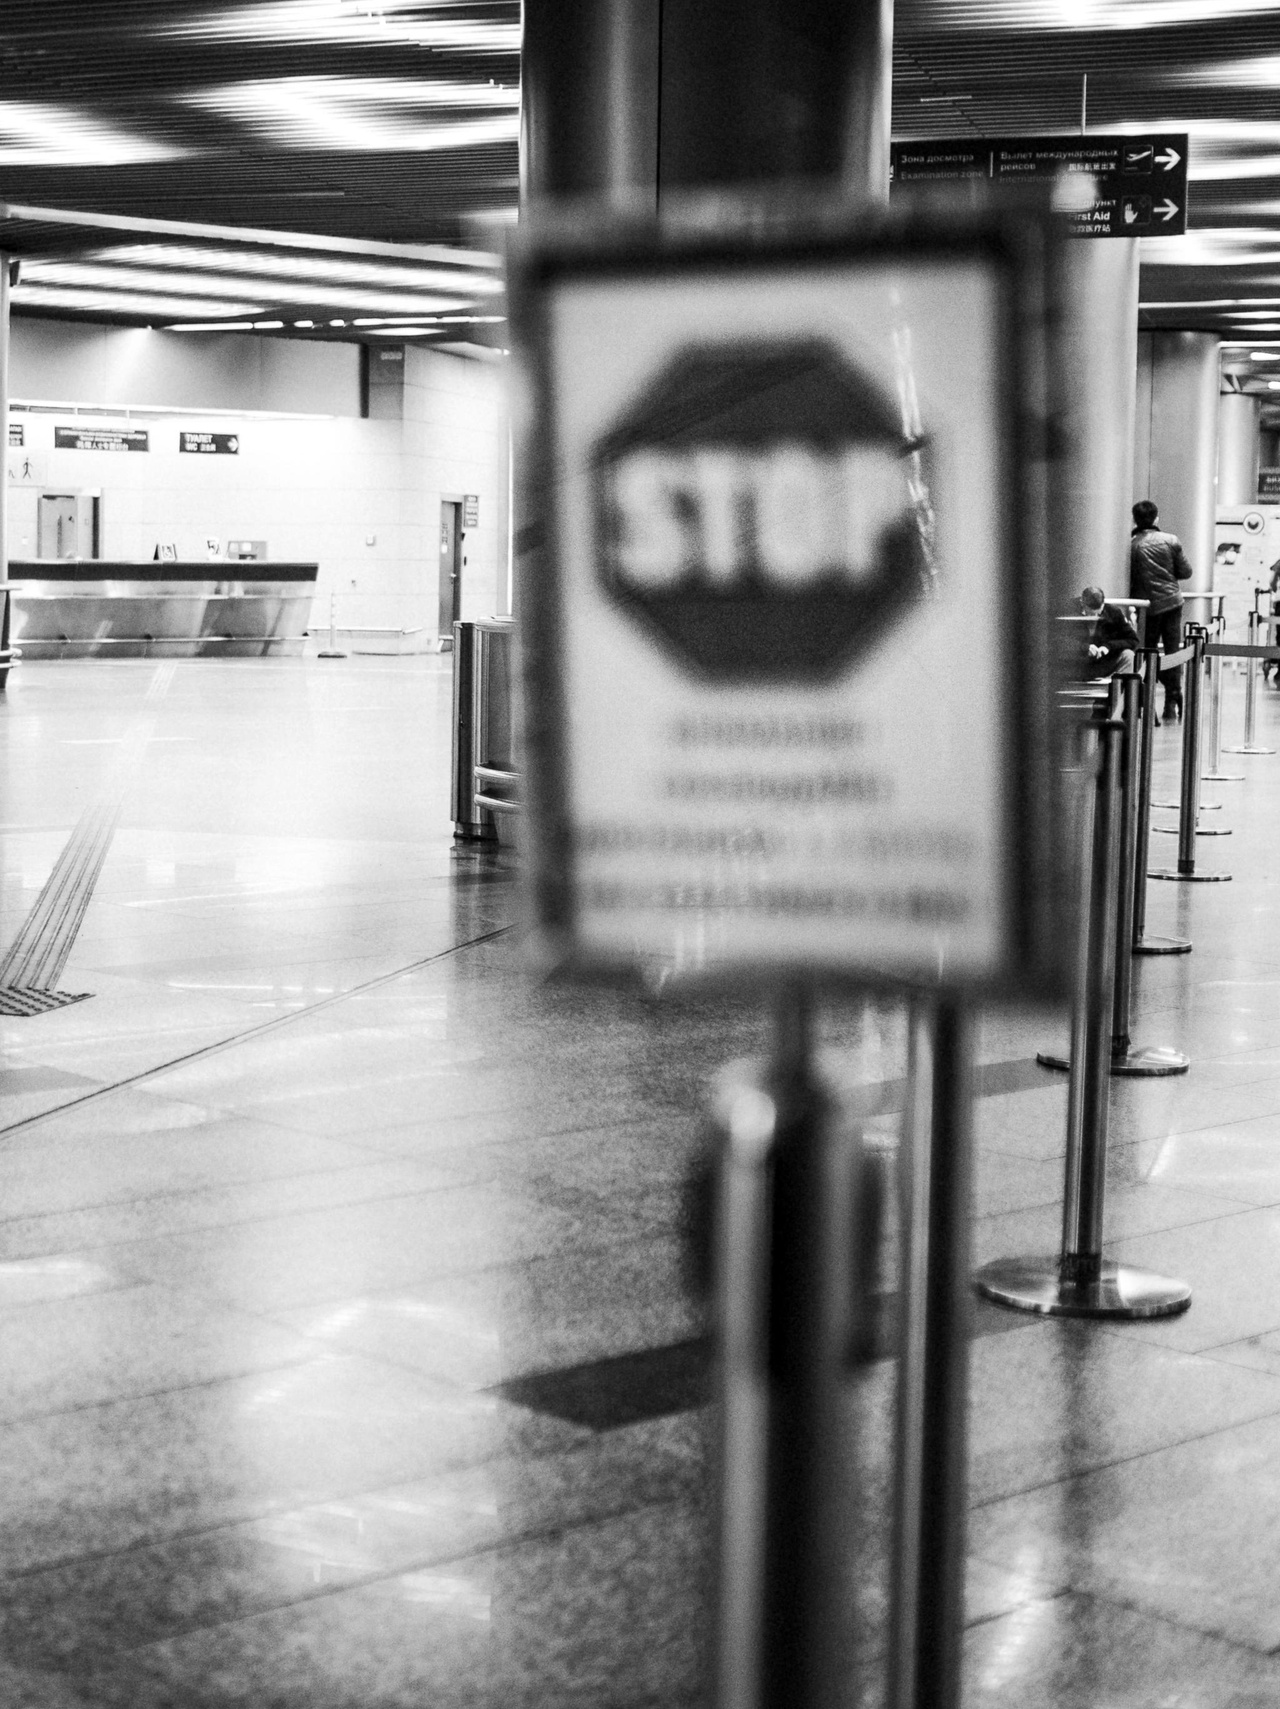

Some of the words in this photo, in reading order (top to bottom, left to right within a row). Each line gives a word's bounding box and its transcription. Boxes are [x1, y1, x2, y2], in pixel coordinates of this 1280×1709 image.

[901, 154, 925, 164] Зона
[927, 154, 975, 163] досмотра
[1001, 151, 1033, 160] Вылет
[1035, 150, 1119, 160] международных
[1000, 163, 1036, 172] рейсов
[901, 171, 959, 180] Examination
[961, 170, 984, 179] zone
[1093, 211, 1111, 221] Aid
[185, 433, 214, 444] ТУАЛЕТ
[185, 442, 198, 451] WC
[614, 442, 915, 586] STOP
